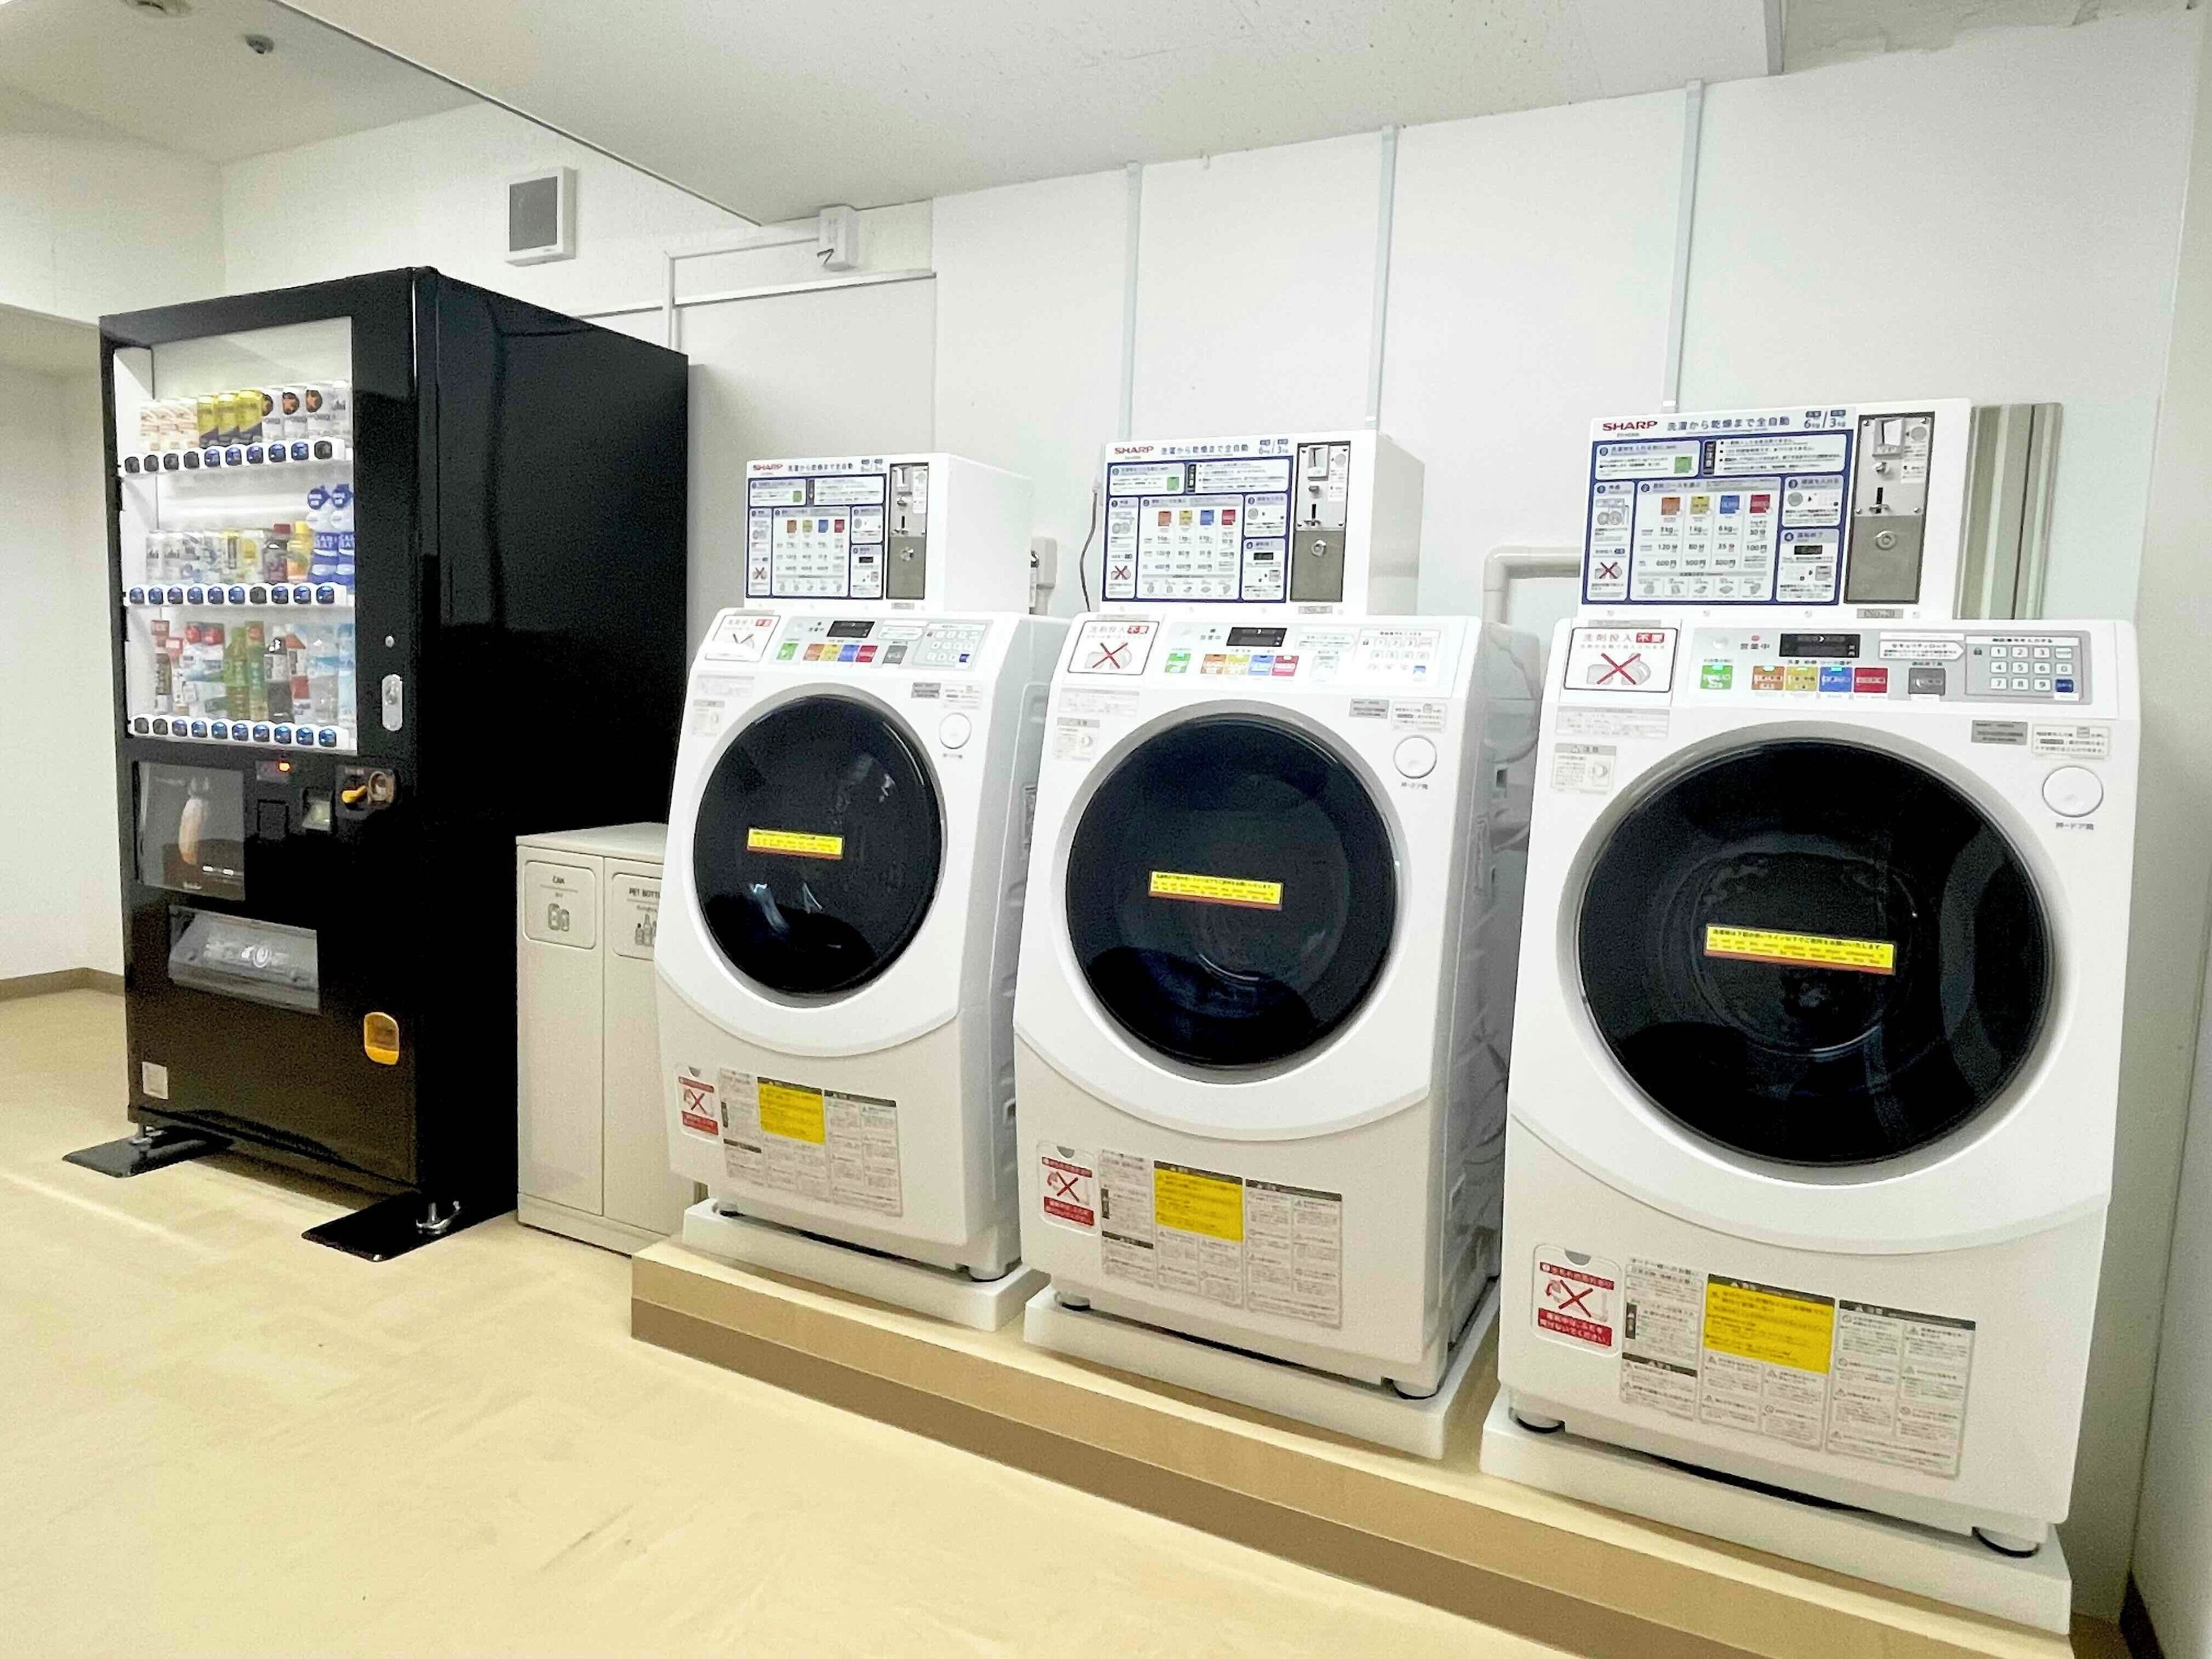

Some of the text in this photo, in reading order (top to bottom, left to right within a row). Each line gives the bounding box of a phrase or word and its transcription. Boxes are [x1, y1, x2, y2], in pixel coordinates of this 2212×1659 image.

[1603, 421, 1658, 431] SHARP
[1115, 446, 1154, 454] SHARP
[552, 876, 565, 884] CAN
